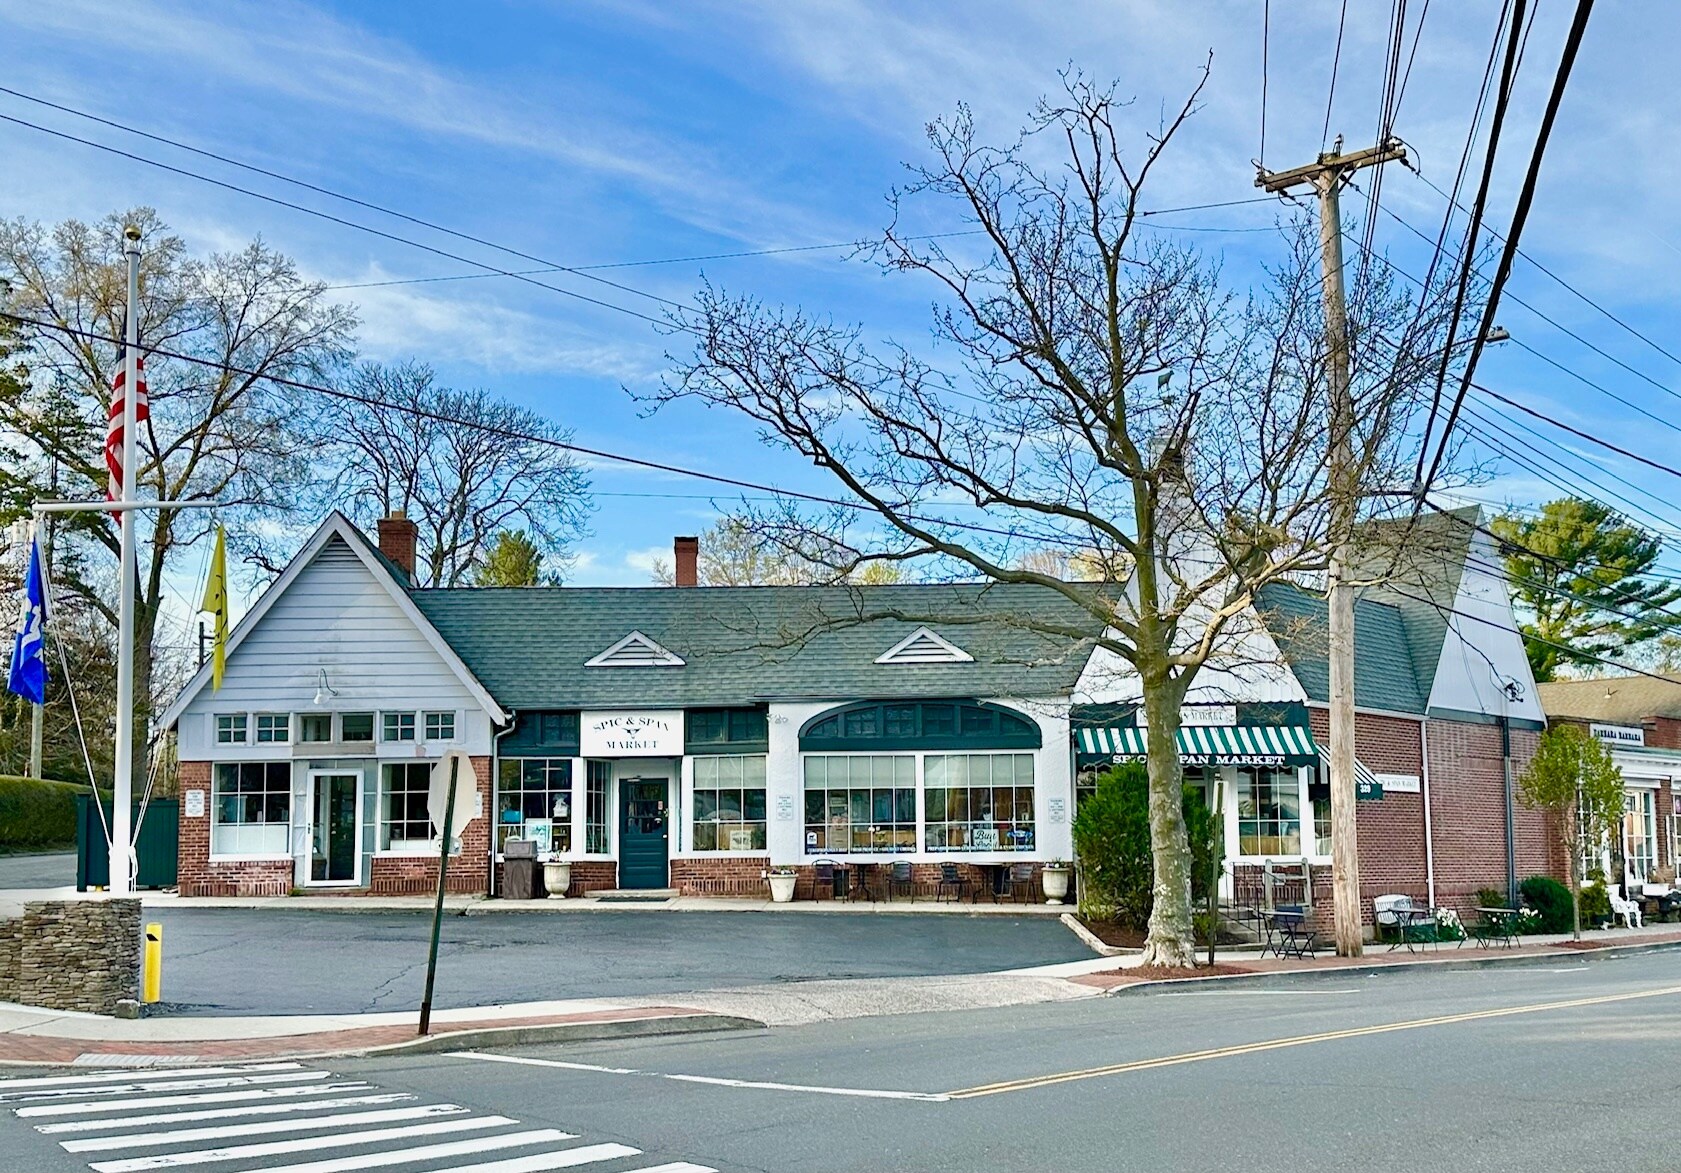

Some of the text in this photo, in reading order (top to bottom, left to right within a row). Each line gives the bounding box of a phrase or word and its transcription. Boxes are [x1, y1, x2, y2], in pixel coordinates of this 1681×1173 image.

[593, 716, 669, 732] SPIC & SPAN
[607, 740, 657, 749] MARKET
[1178, 755, 1209, 765] PAN
[1215, 755, 1286, 765] MARKET
[974, 829, 997, 843] Buy
